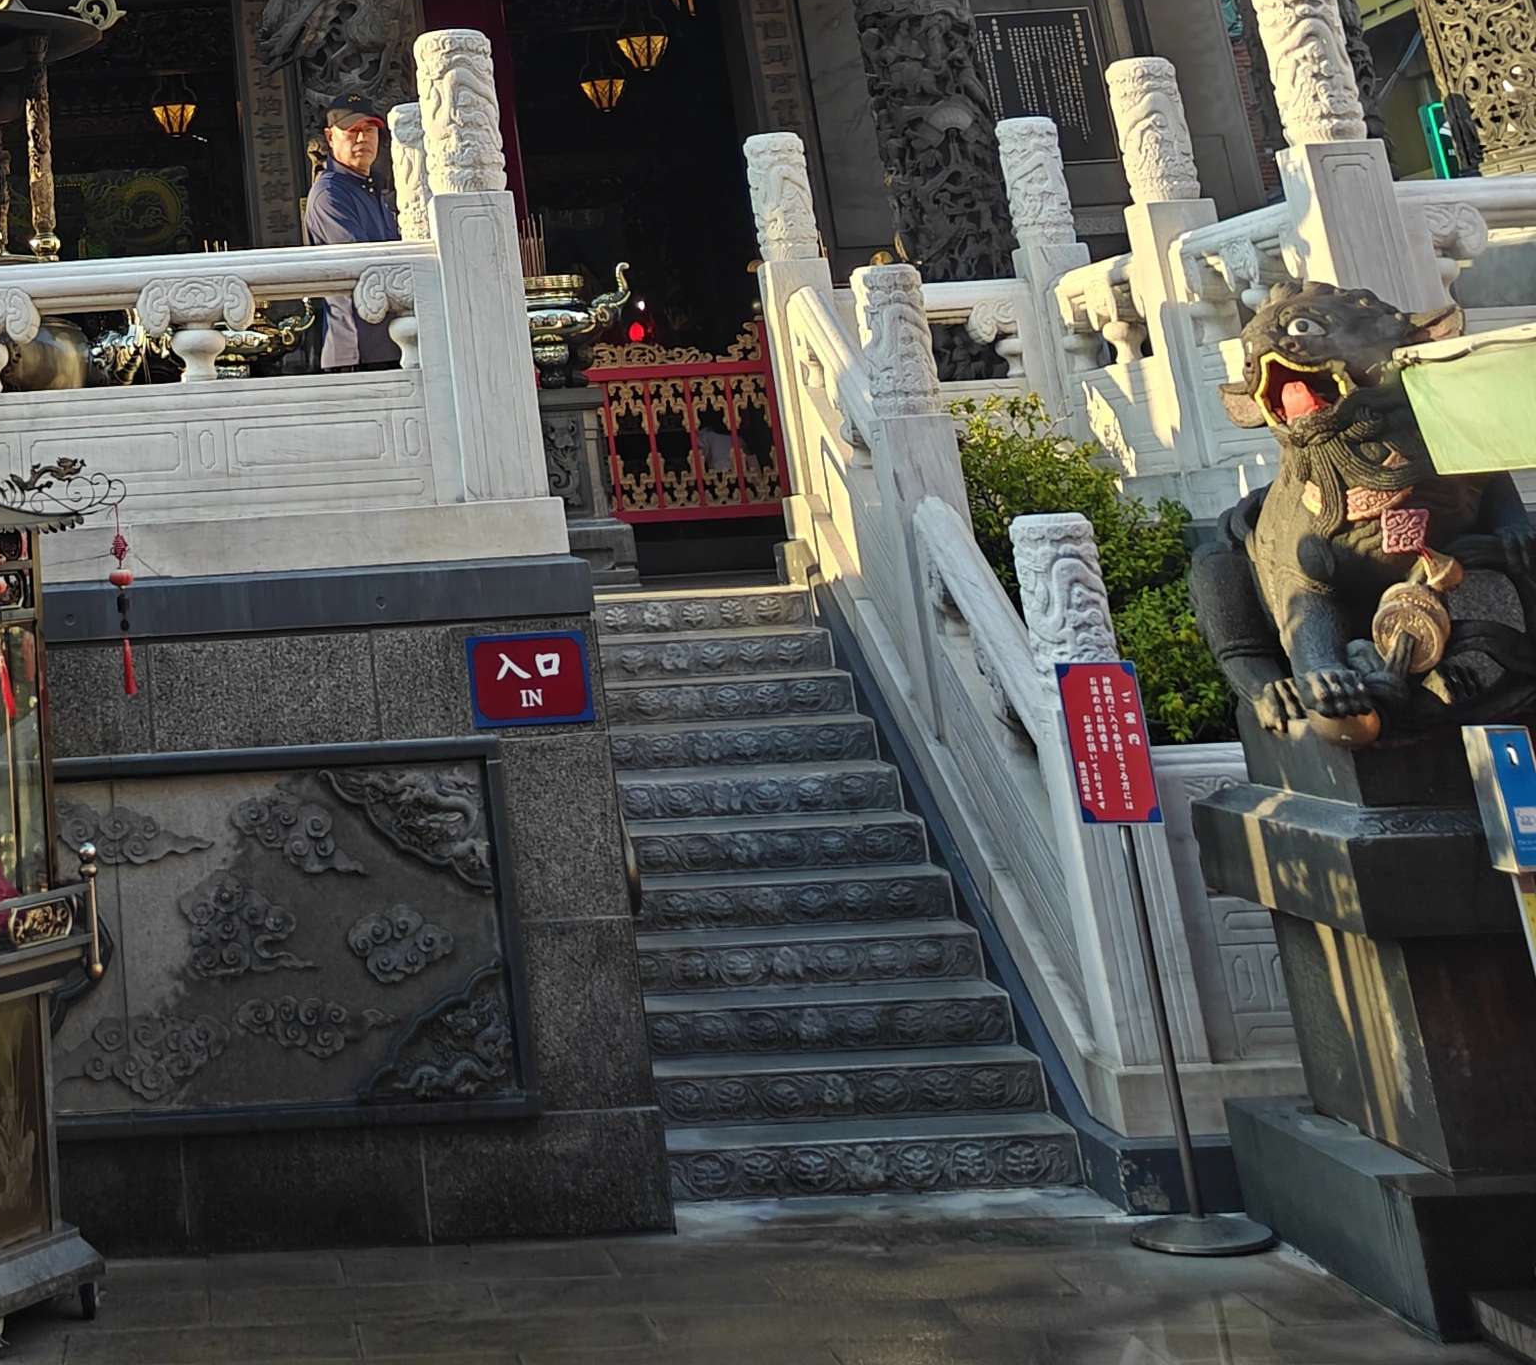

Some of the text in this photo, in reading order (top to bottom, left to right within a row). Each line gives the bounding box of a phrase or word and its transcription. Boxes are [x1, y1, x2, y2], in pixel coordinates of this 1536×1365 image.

[496, 652, 561, 681] 入口
[519, 689, 543, 708] IN
[1121, 690, 1141, 745] ご案内
